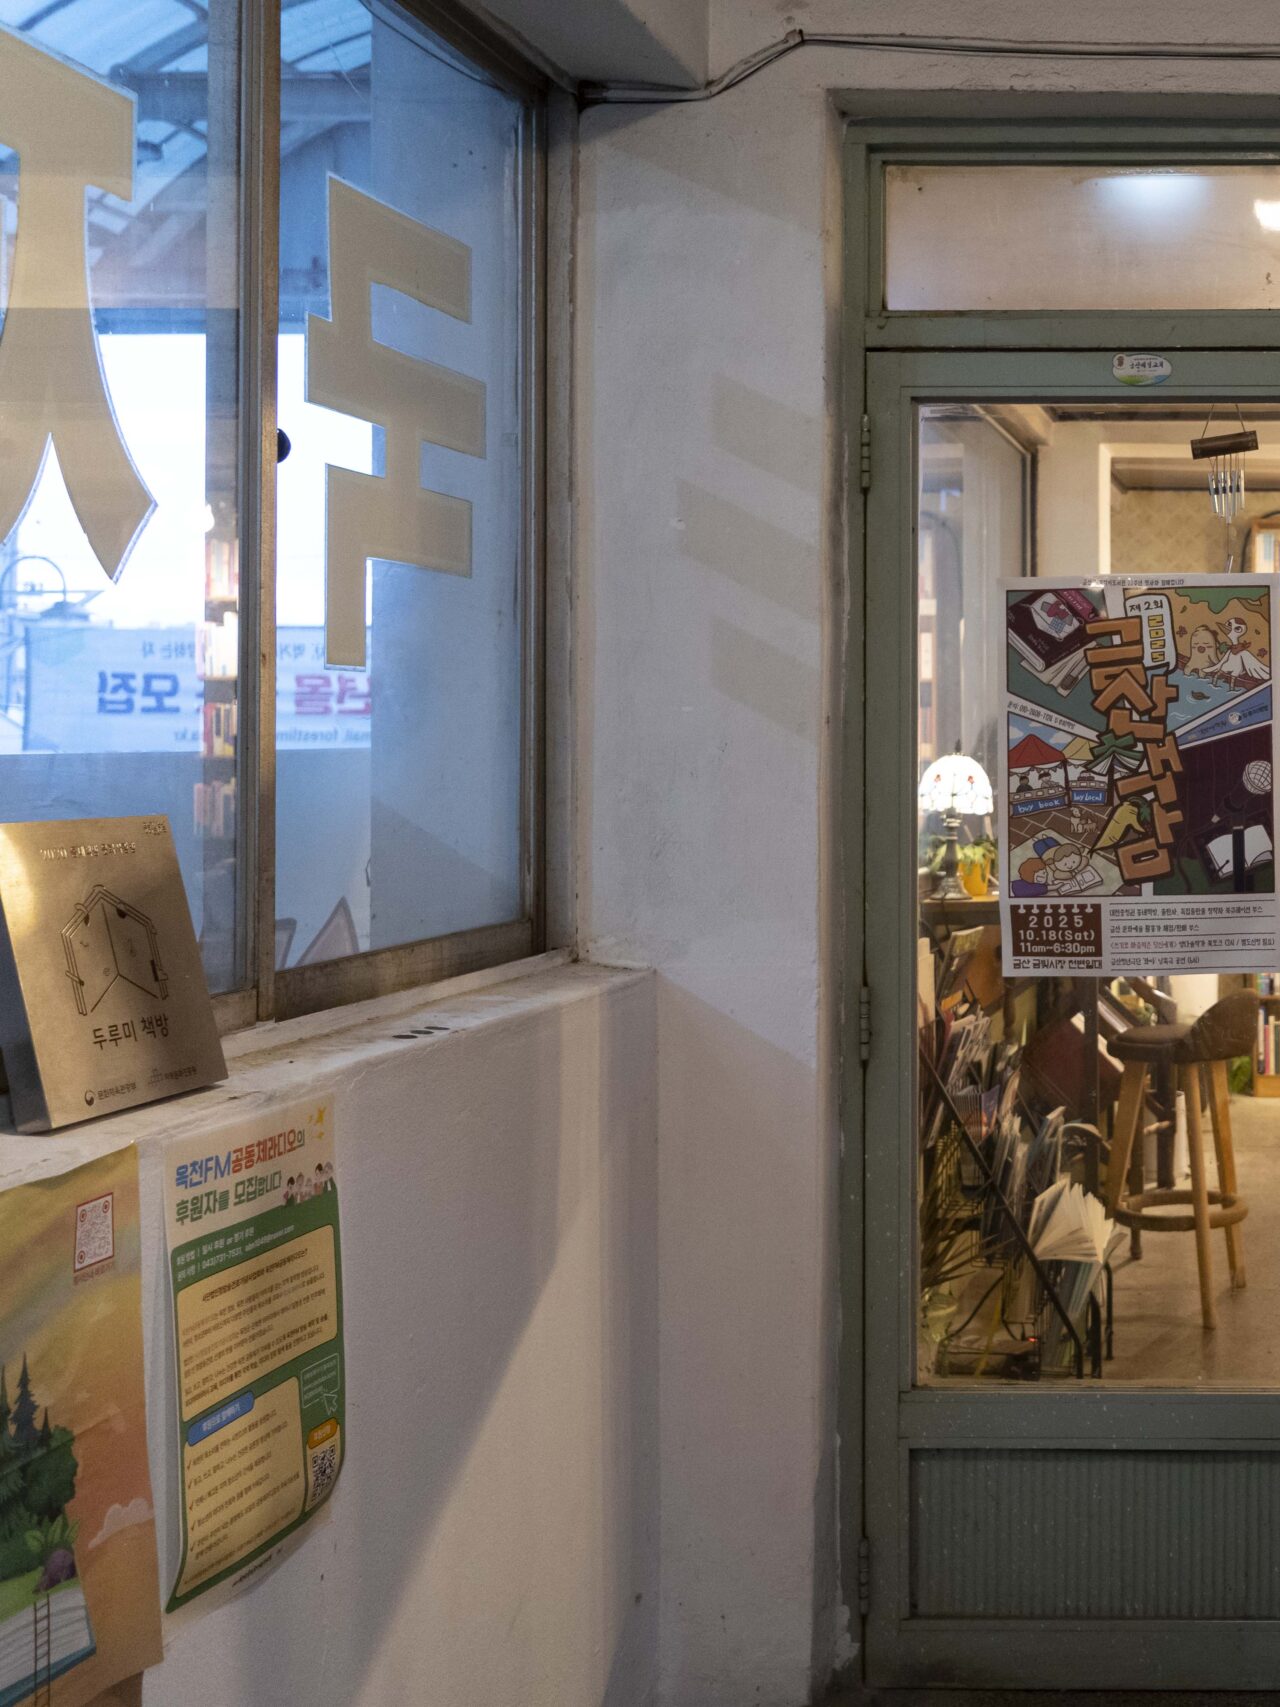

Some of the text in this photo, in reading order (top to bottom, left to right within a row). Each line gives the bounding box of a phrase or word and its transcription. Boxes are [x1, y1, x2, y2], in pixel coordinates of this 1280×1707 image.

[1129, 604, 1141, 612] 제
[1018, 800, 1060, 813] buy book
[1028, 915, 1084, 928] 2025
[1018, 929, 1095, 942] 10.18(Sat)
[1013, 958, 1030, 969] 금산
[1032, 958, 1066, 969] 금빛시장
[92, 1014, 169, 1049] 두루미 책방
[176, 1128, 305, 1189] 옥천FM공동체라디오의
[176, 1170, 282, 1226] 후원자를 모집합니다
